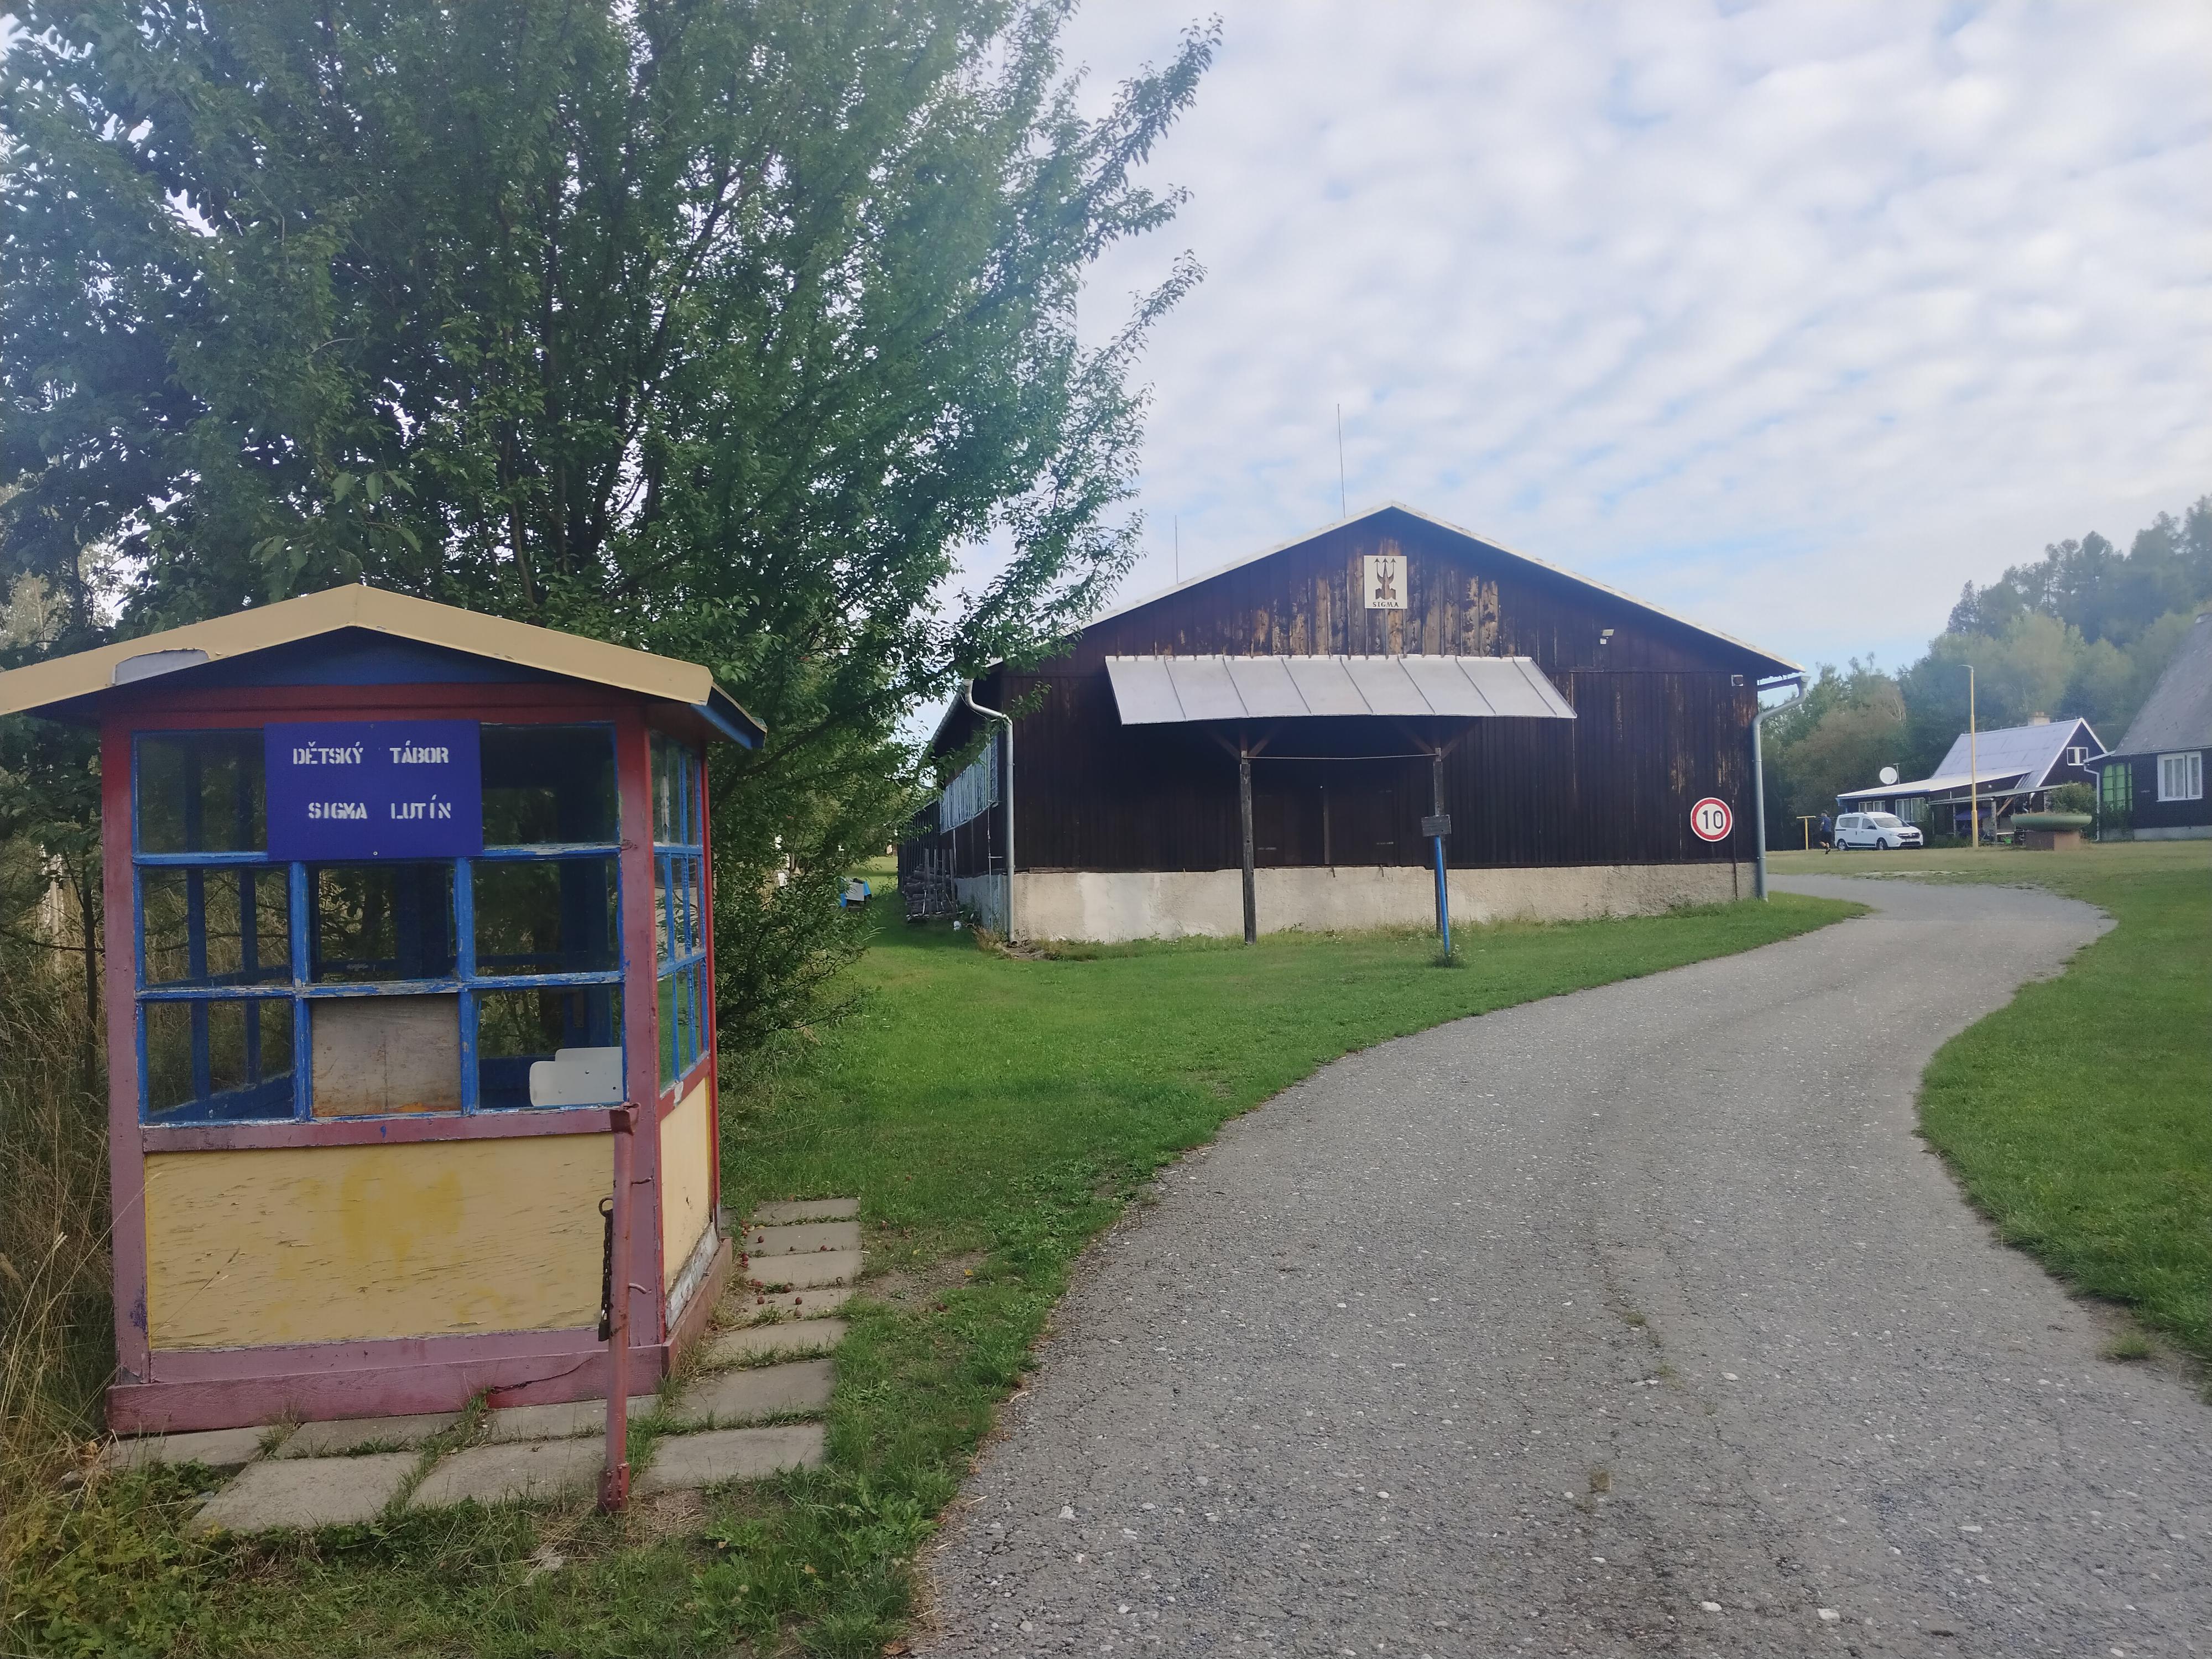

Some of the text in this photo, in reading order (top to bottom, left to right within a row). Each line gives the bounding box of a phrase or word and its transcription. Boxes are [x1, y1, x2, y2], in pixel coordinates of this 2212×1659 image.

[293, 740, 449, 764] DĚTSKÝ TÁBOR
[308, 794, 451, 820] SIGMA LUTÍN
[1702, 810, 1724, 830] 10
